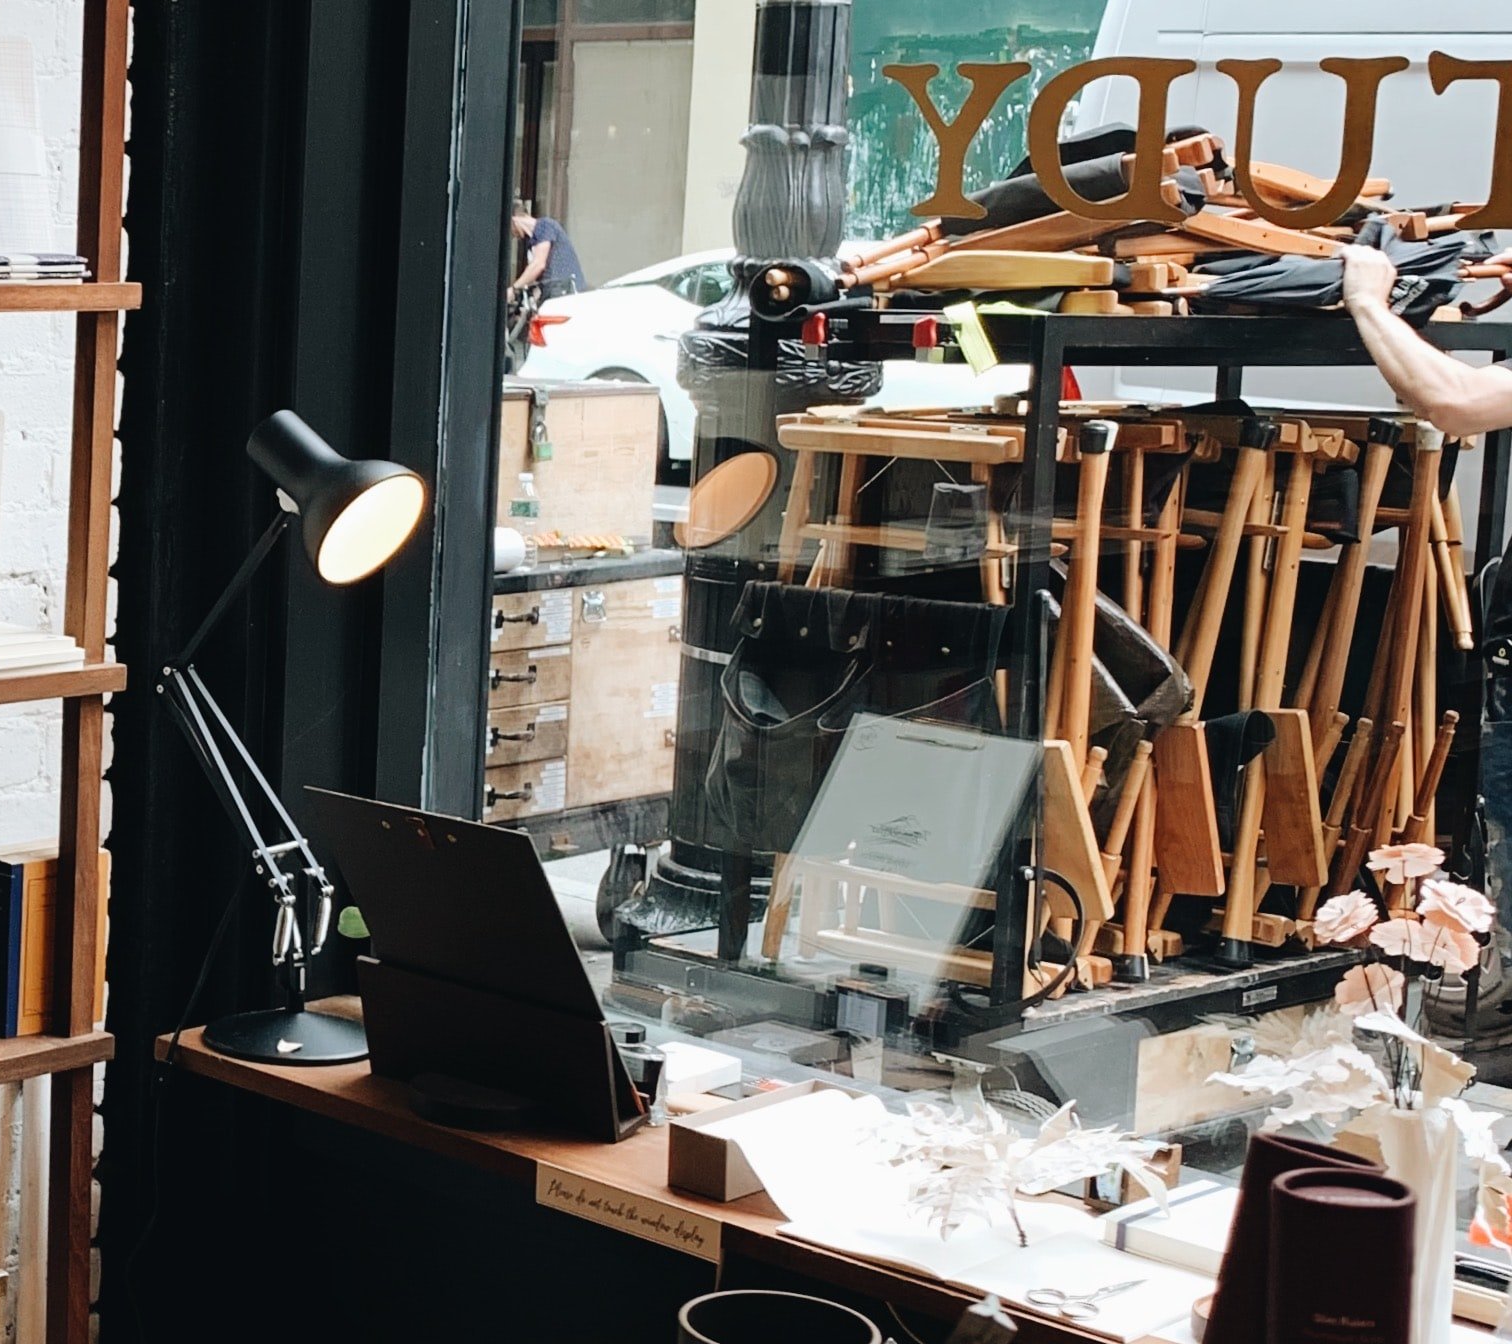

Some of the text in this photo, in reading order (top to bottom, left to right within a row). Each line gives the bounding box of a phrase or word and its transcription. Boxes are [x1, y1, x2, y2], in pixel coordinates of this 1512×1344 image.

[547, 1178, 571, 1201] Please
[575, 1188, 586, 1205] do
[589, 1198, 602, 1211] not
[626, 1206, 638, 1221] the
[673, 1220, 705, 1249] display
